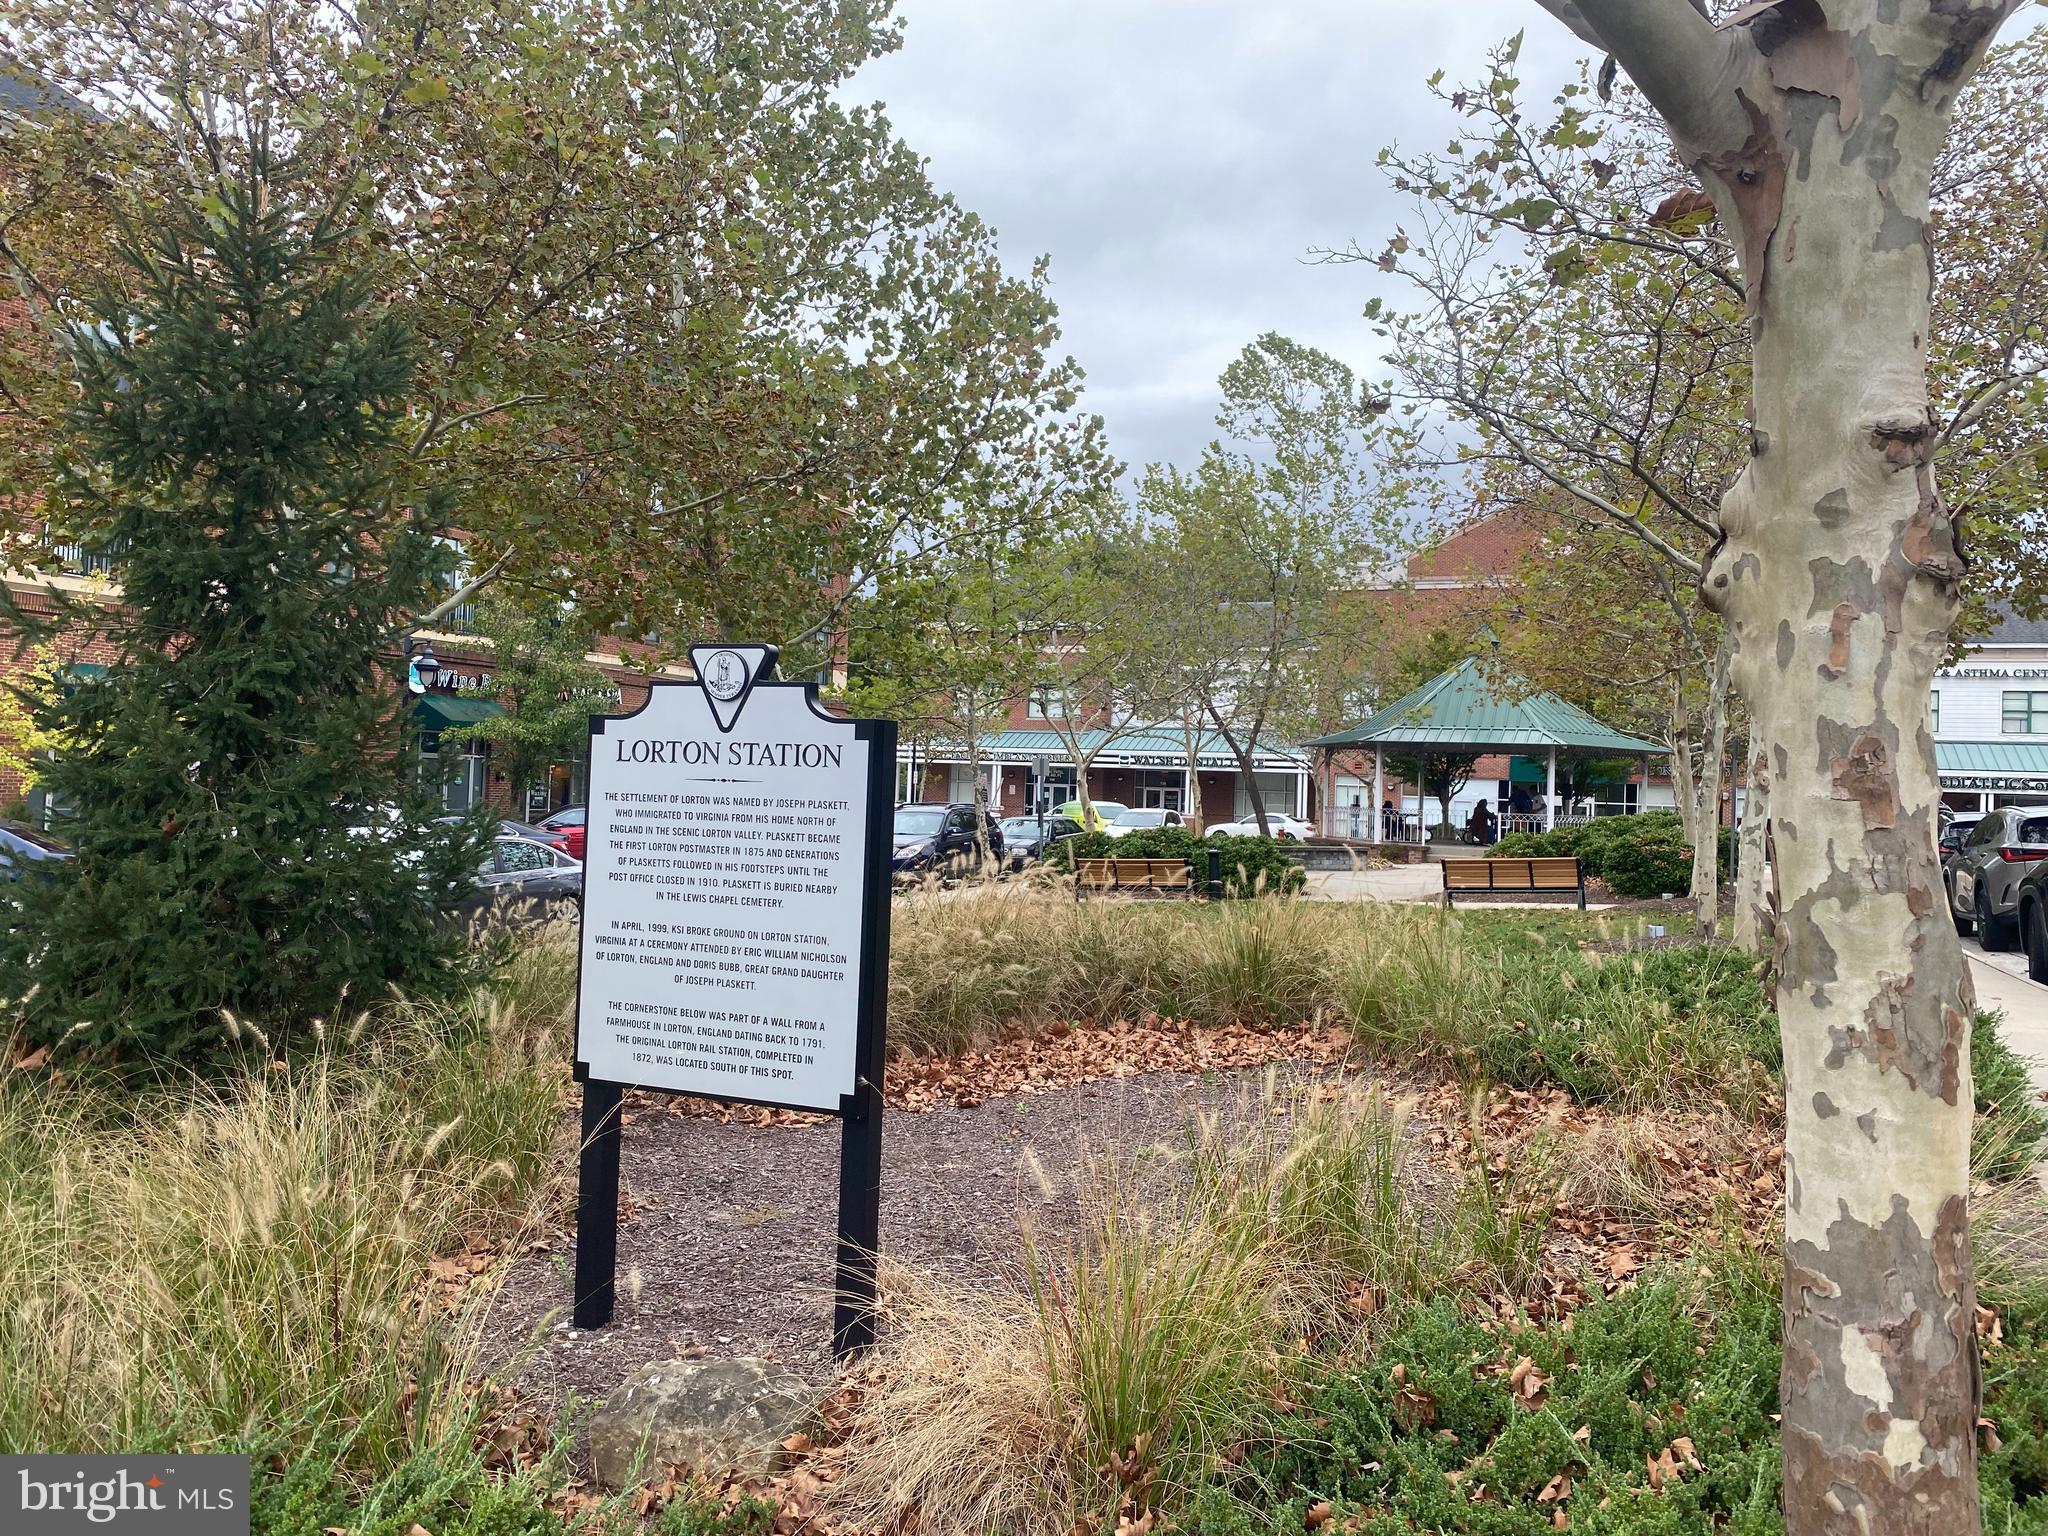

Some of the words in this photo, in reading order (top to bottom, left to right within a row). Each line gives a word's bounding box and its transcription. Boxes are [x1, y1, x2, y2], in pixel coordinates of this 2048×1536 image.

[437, 668, 477, 690] Wine
[1940, 668, 1950, 678] &
[1955, 668, 2009, 678] ASTHMA
[616, 740, 721, 763] LORTON
[729, 742, 843, 767] STATION
[1133, 755, 1175, 767] WALSH
[1180, 756, 1228, 768] DNTAL
[1230, 757, 1266, 770] CRE
[1940, 776, 2030, 790] EDIATRICS
[604, 792, 619, 801] THE
[620, 792, 668, 802] SETTLEMENT
[669, 794, 680, 803] OF
[681, 795, 711, 804] LORTON
[712, 796, 731, 805] WAS
[732, 796, 761, 806] NAMED
[762, 798, 774, 807] BY
[775, 798, 806, 808] JOSEPH
[807, 799, 850, 810] PLASKETT,
[615, 808, 633, 817] WHO
[634, 809, 682, 819] IMMIGRATED
[683, 811, 694, 820] TO
[695, 812, 729, 821] VIRGINIA
[731, 813, 753, 822] FROM
[755, 814, 769, 823] HIS
[771, 815, 795, 824] HOME
[796, 816, 824, 825] NORTH
[826, 817, 837, 826] OF
[609, 824, 644, 834] ENGLAND
[645, 825, 654, 834] IN
[655, 826, 670, 835] THE
[672, 827, 700, 837] SCENIC
[701, 828, 732, 838] LORTON
[733, 830, 764, 839] VALLEY.
[765, 831, 806, 841] PLASKETT
[807, 833, 841, 843] BECAME
[609, 839, 624, 849] THE
[625, 840, 647, 850] FIRST
[648, 842, 678, 851] LORTON
[679, 843, 731, 854] POSTMASTER
[732, 846, 741, 855] IN
[744, 847, 764, 856] 1875
[766, 848, 783, 857] AND
[784, 849, 840, 860] GENERATIONS
[617, 856, 628, 865] OF
[628, 857, 671, 868] PLASKETTS
[672, 859, 713, 870] FOLLOWED
[714, 862, 723, 870] IN
[724, 862, 739, 871] HIS
[740, 863, 785, 874] FOOTSTEPS
[787, 866, 811, 876] UNTIL
[812, 867, 829, 877] THE
[608, 871, 628, 881] POST
[629, 873, 655, 883] OFFICE
[656, 874, 685, 885] CLOSED
[687, 876, 696, 885] IN
[698, 877, 720, 887] 1910.
[722, 878, 762, 889] PLASKETT
[763, 881, 772, 890] IS
[773, 881, 803, 892] BURIED
[805, 884, 838, 894] NEARBY
[655, 891, 665, 899] IN
[666, 891, 681, 901] THE
[682, 892, 707, 903] LEWIS
[708, 894, 739, 905] CHAPEL
[740, 896, 784, 908] CEMETERY.
[611, 920, 620, 929] IN
[621, 921, 645, 931] APRIL,
[647, 923, 670, 933] 1999,
[671, 924, 685, 934] KSI
[686, 925, 712, 936] BROKE
[713, 927, 746, 938] GROUND
[747, 930, 759, 939] ON
[760, 931, 792, 942] LORTON
[793, 934, 830, 945] STATION,
[594, 935, 627, 946] VIRGINIA
[628, 937, 638, 946] AT
[639, 938, 645, 947] A
[646, 939, 689, 950] CEREMONY
[690, 942, 730, 954] ATTENDED
[731, 945, 742, 955] BY
[743, 946, 762, 957] ERIC
[764, 948, 799, 959] WILLIAM
[800, 951, 847, 964] NICHOLSON
[595, 951, 606, 960] OF
[606, 952, 638, 964] LORTON,
[639, 954, 674, 966] ENGLAND
[675, 958, 692, 967] AND
[693, 959, 717, 969] DORIS
[718, 961, 743, 973] BUBB,
[744, 963, 770, 974] GREAT
[771, 966, 799, 977] GRAND
[800, 968, 844, 981] DAUGHTER
[674, 974, 684, 983] OF
[685, 975, 714, 986] JOSEPH
[716, 978, 757, 990] PLASKETT.
[608, 1000, 623, 1010] THE
[624, 1002, 678, 1016] CORNERSTONE
[679, 1007, 707, 1018] BELOW
[708, 1010, 727, 1021] WAS
[728, 1012, 749, 1023] PART
[750, 1015, 761, 1024] OF
[762, 1016, 769, 1025] A
[770, 1017, 793, 1028] WALL
[794, 1019, 817, 1030] FROM
[819, 1022, 825, 1031] A
[606, 1016, 651, 1030] FARMHOUSE
[653, 1021, 662, 1030] IN
[663, 1023, 695, 1035] LORTON,
[697, 1026, 733, 1038] ENGLAND
[734, 1030, 763, 1041] DATING
[765, 1033, 787, 1044] BACK
[788, 1035, 799, 1045] TO
[802, 1037, 826, 1048] 1791.
[615, 1033, 630, 1044] THE
[631, 1035, 666, 1048] ORIGINAL
[667, 1040, 698, 1051] LORTON
[699, 1043, 717, 1053] RAIL
[718, 1045, 753, 1059] STATION,
[755, 1049, 803, 1063] COMPLETED
[804, 1055, 814, 1064] IN
[632, 1052, 654, 1064] 1872,
[655, 1055, 673, 1065] WAS
[675, 1057, 709, 1069] LOCATED
[710, 1061, 737, 1072] SOUTH
[738, 1064, 749, 1074] OF
[750, 1065, 769, 1077] THIS
[771, 1068, 794, 1080] SPOT.
